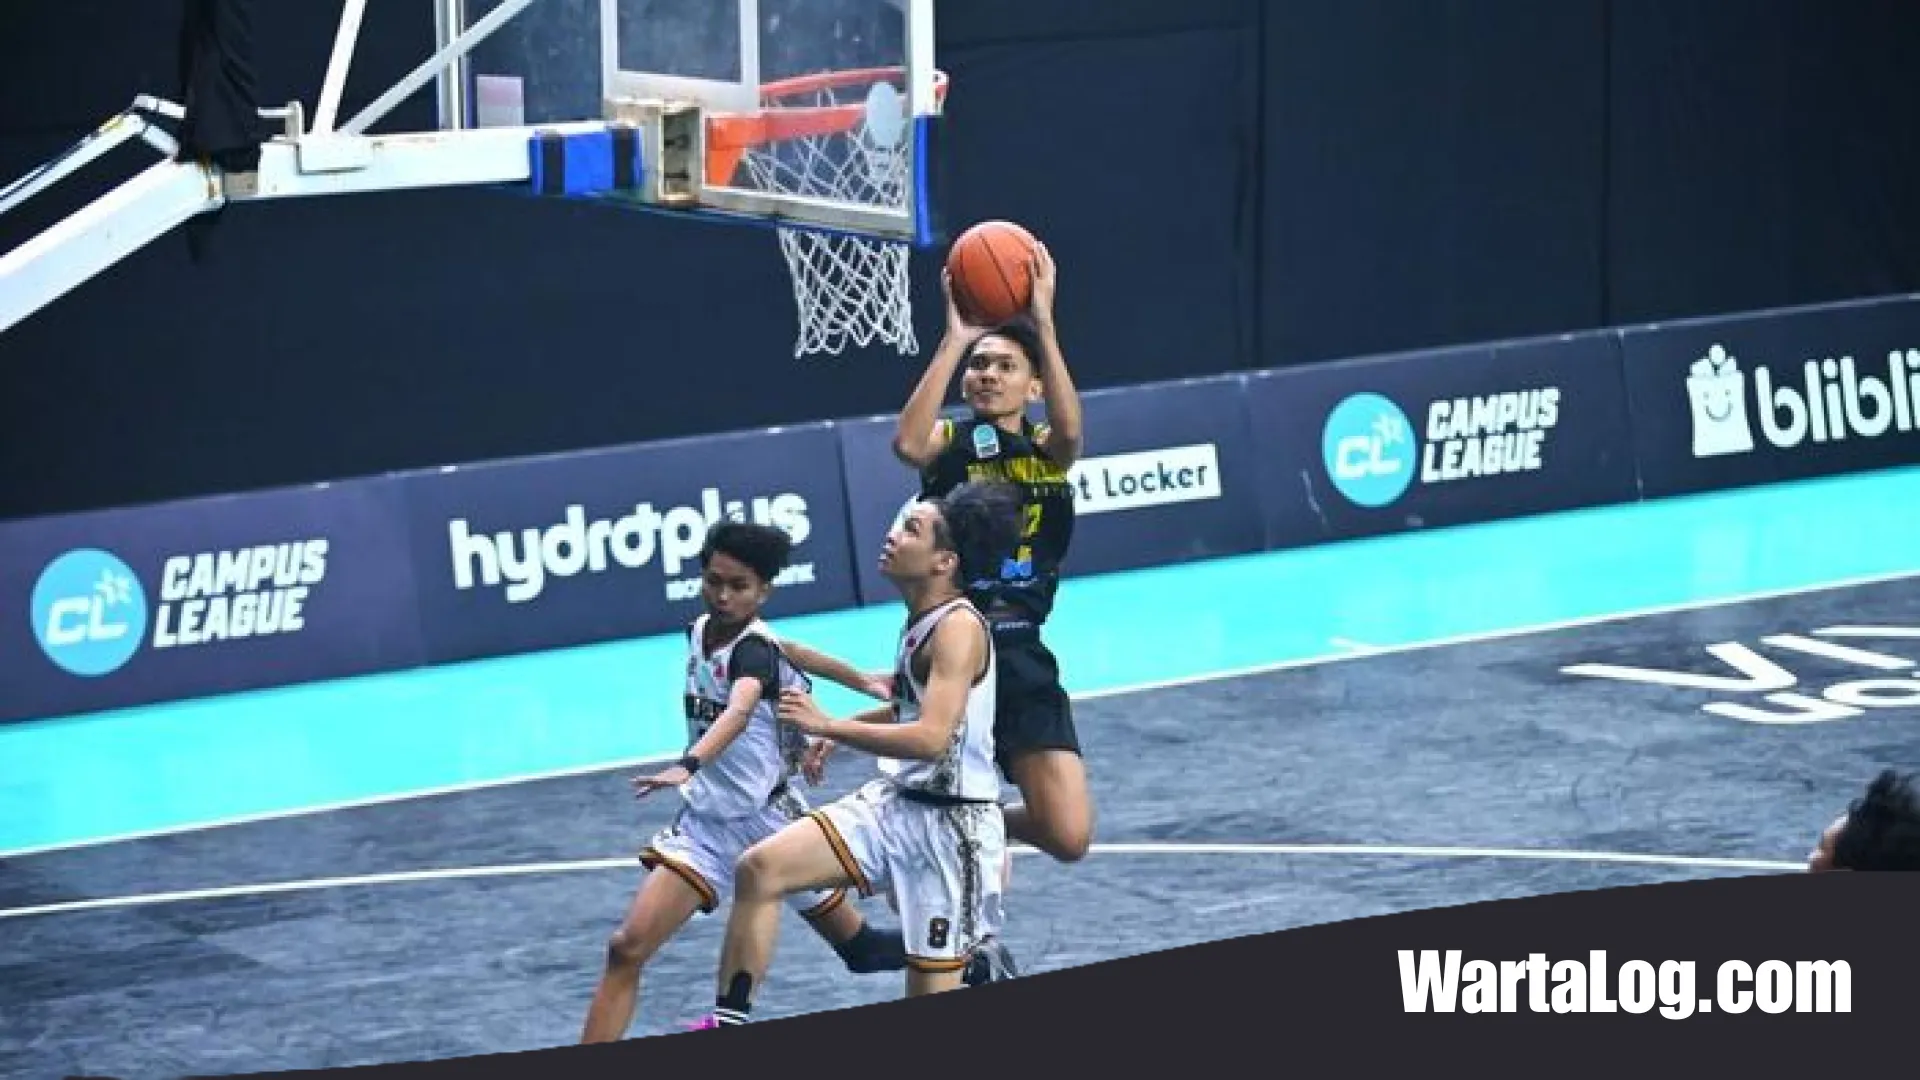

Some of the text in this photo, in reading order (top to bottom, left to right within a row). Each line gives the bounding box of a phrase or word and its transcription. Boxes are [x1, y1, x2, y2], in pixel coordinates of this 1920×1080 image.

[1427, 386, 1561, 441] CAMPUS
[1754, 348, 1920, 448] blibli
[1103, 460, 1208, 497] Locker
[1421, 429, 1545, 483] LEAGUE
[161, 538, 330, 601] CAMPUS
[153, 586, 309, 648] LEAGUE
[927, 916, 950, 949] 8
